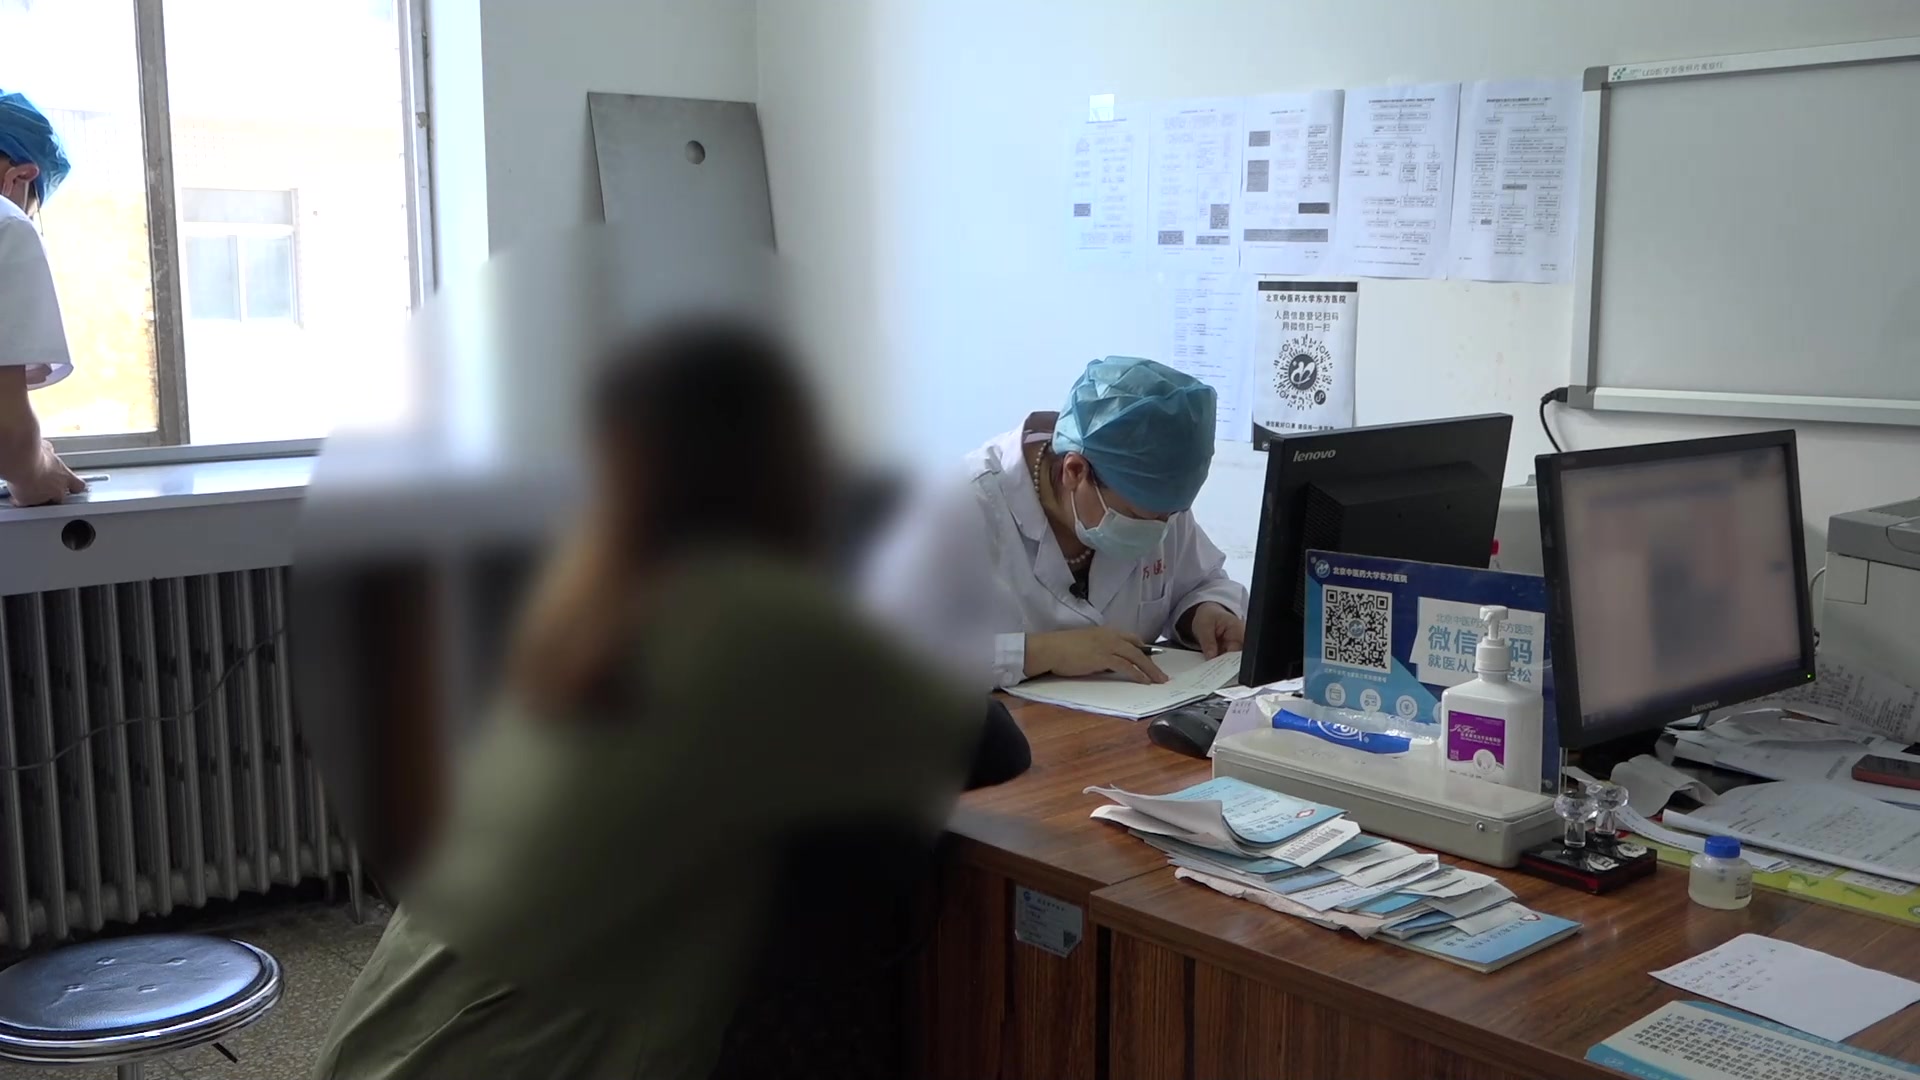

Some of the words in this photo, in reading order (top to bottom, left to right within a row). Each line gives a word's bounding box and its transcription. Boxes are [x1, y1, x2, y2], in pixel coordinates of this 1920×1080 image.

[1265, 294, 1347, 304] 北京中医药大学东方医院
[1274, 310, 1339, 321] 人员信息登记扫码
[1282, 322, 1331, 332] 用微信扫一扫
[1292, 449, 1337, 463] lenovo
[1332, 566, 1408, 584] 北京中医药大学东方医院
[1428, 624, 1533, 665] 微信码
